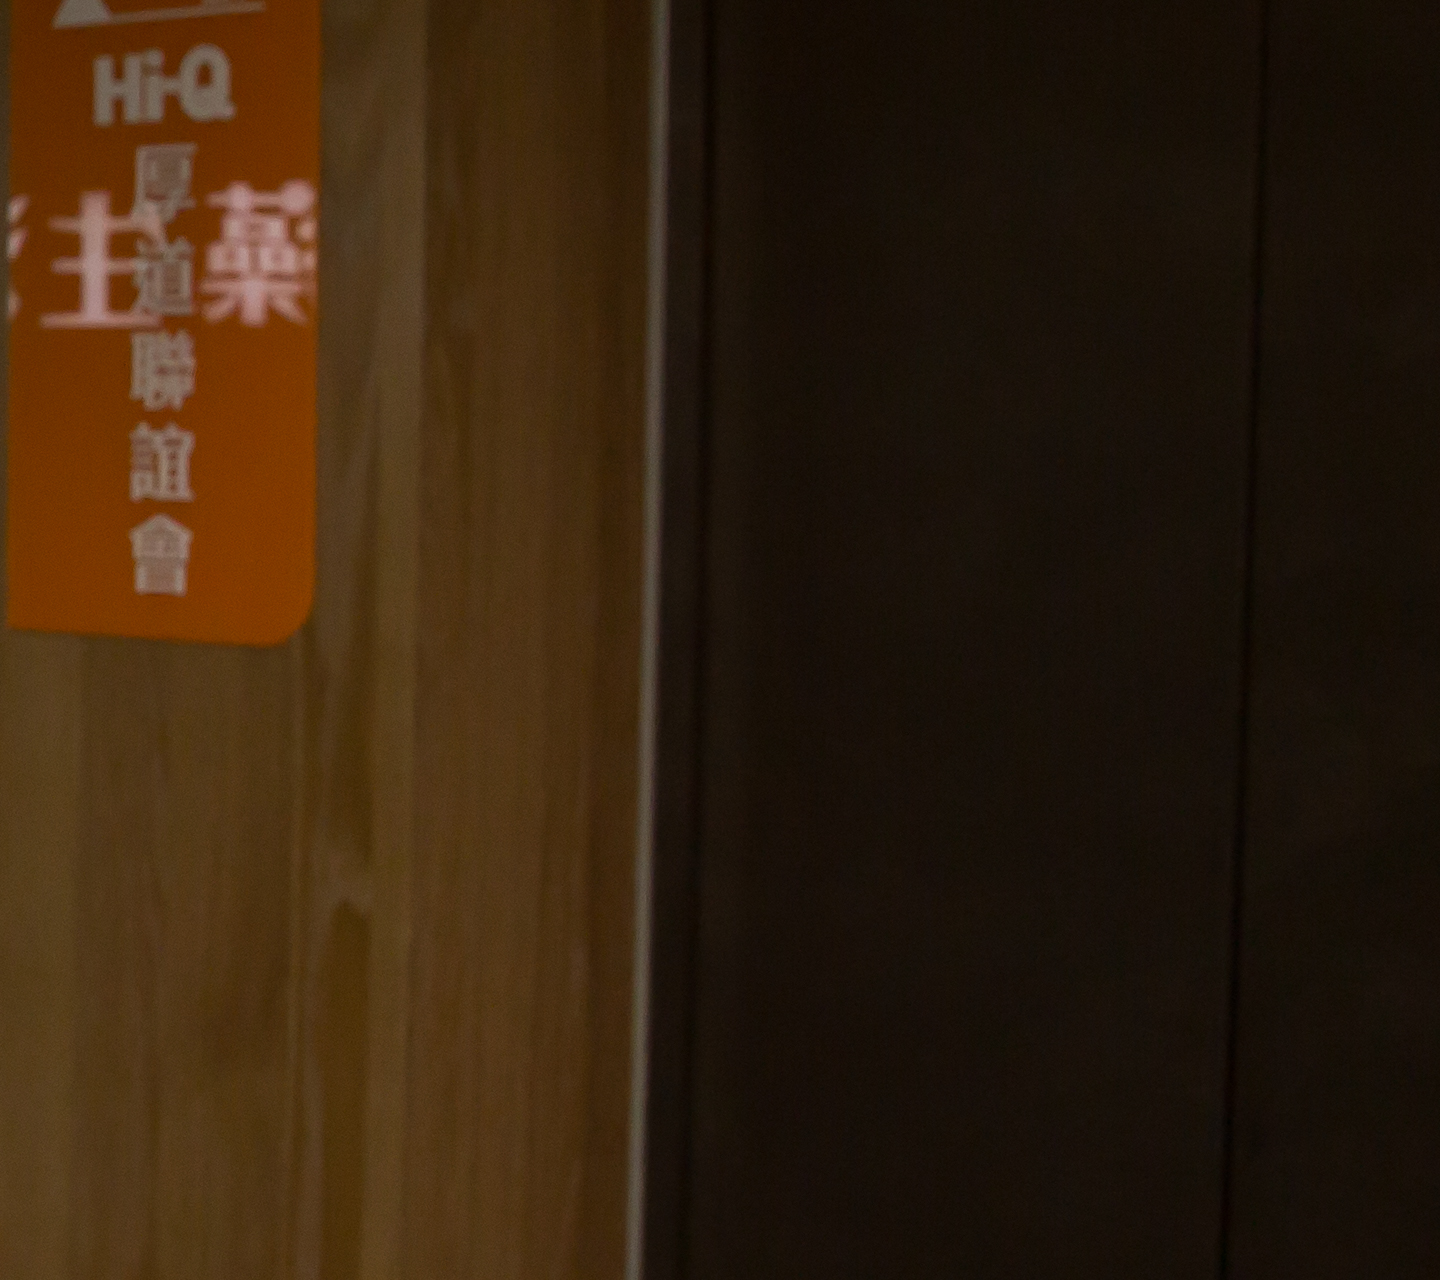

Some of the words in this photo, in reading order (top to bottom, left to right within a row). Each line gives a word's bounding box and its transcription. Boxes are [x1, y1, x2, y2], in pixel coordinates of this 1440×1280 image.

[92, 42, 237, 128] Hi-Q
[129, 142, 198, 597] 厚道聯誼會
